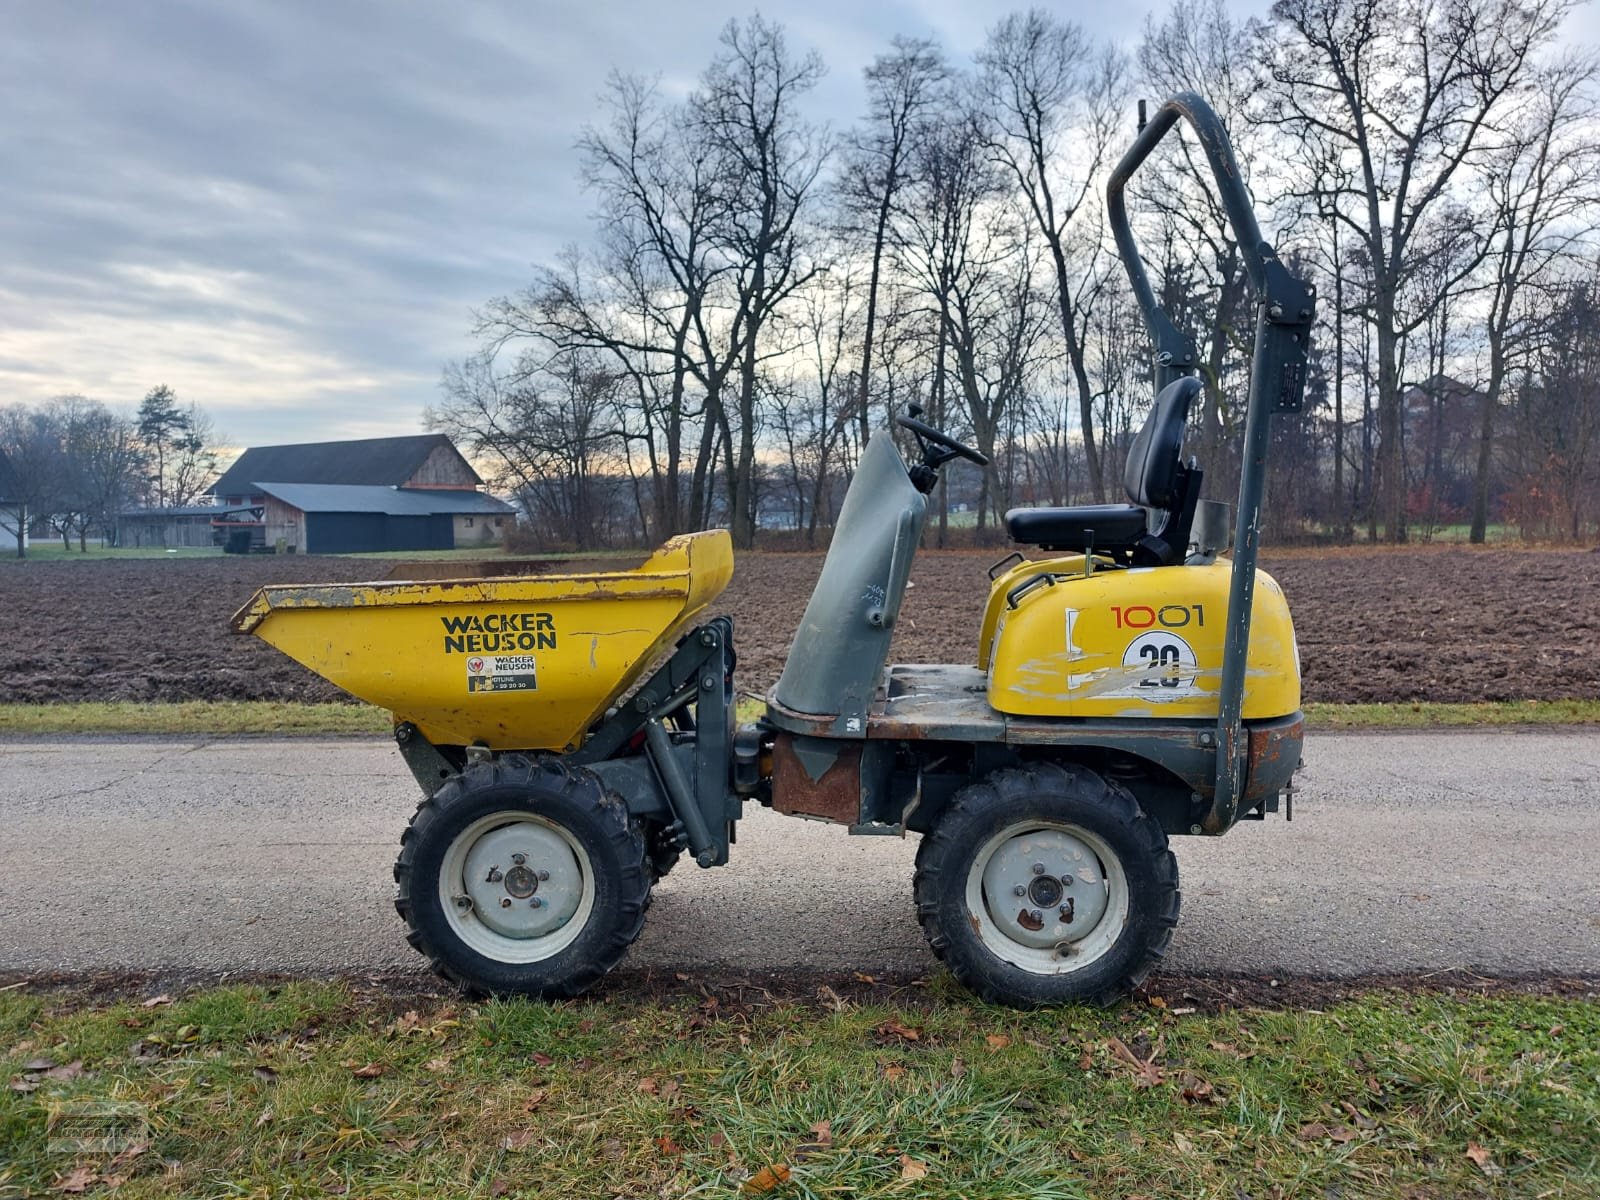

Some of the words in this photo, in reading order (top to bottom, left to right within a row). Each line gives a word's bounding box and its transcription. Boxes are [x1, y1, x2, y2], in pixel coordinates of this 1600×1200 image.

[440, 612, 556, 634] WACKER
[1110, 604, 1204, 629] 1001
[444, 632, 557, 653] NEUSON
[495, 663, 535, 671] NEUSON
[1139, 644, 1180, 688] 20
